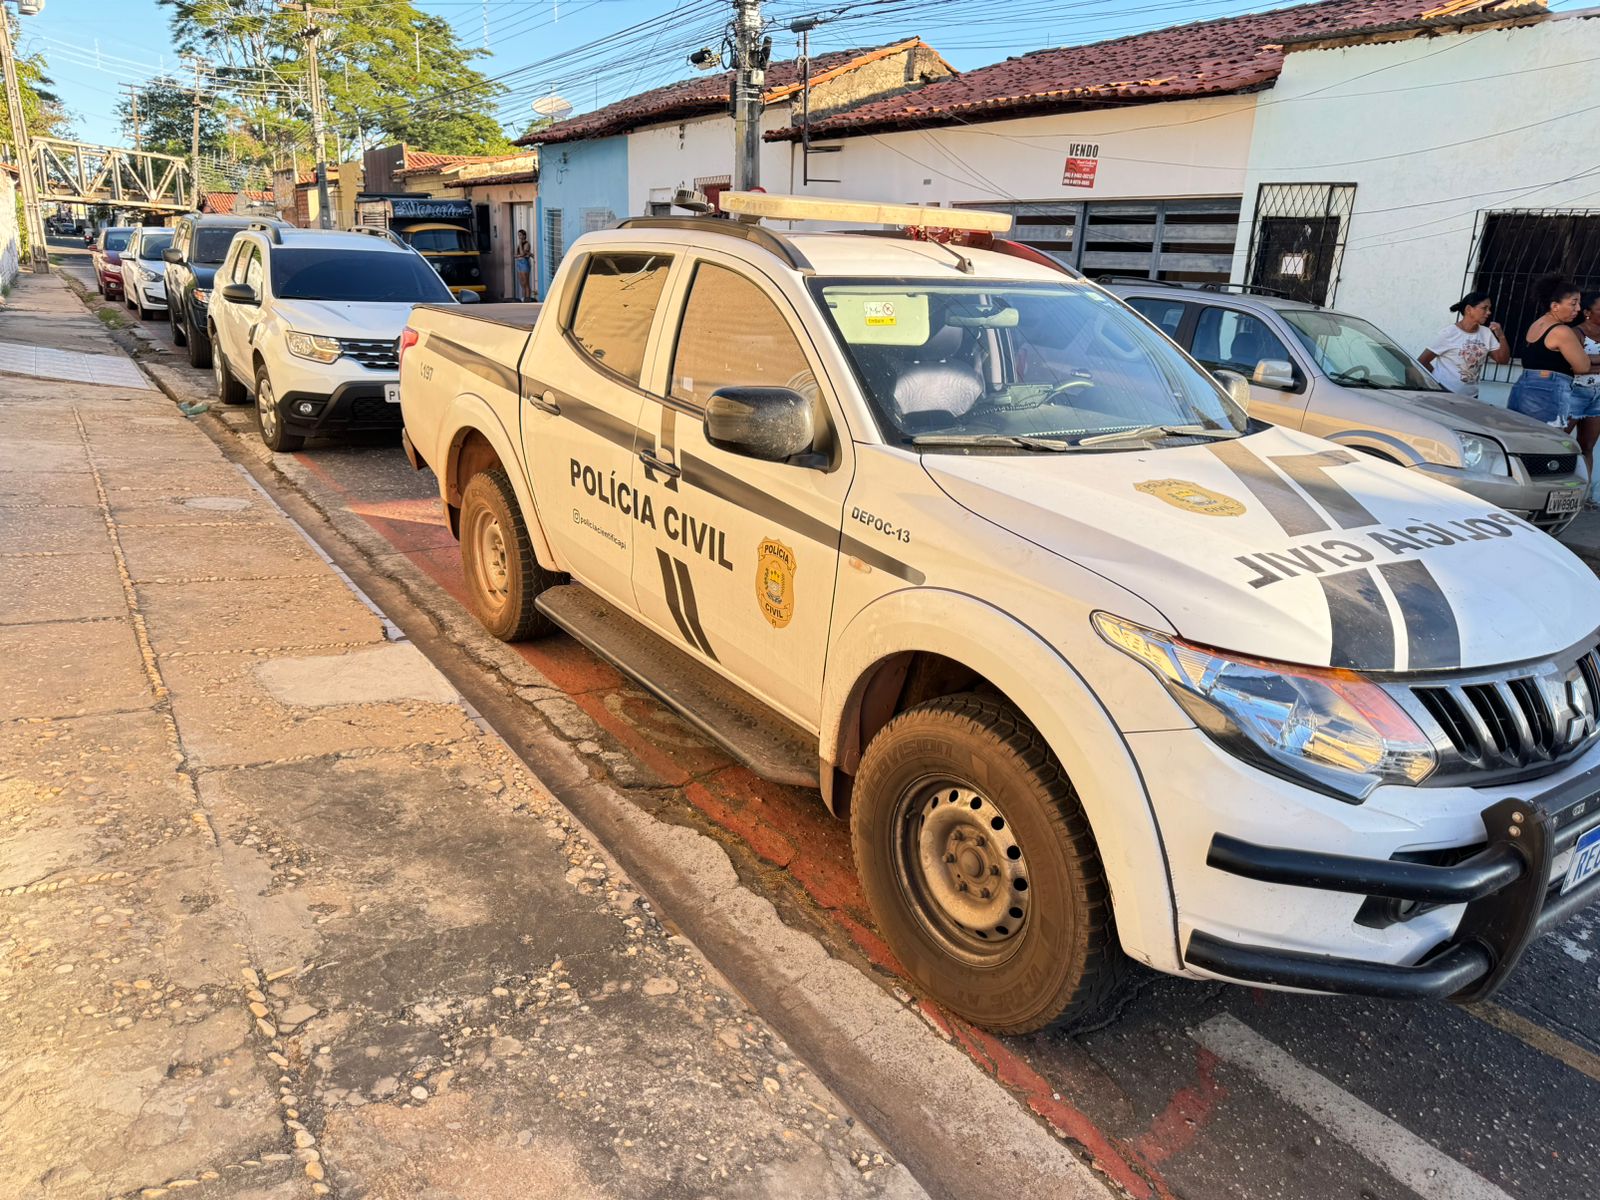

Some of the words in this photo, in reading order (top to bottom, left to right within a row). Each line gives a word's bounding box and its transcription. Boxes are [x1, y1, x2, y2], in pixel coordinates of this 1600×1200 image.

[1069, 143, 1099, 158] VENDO
[570, 458, 656, 530] POLÍCIA
[663, 505, 733, 572] CIVIL
[851, 506, 911, 543] DEPOC-13
[764, 544, 789, 564] POLÍCIA
[765, 603, 783, 618] CIVIL
